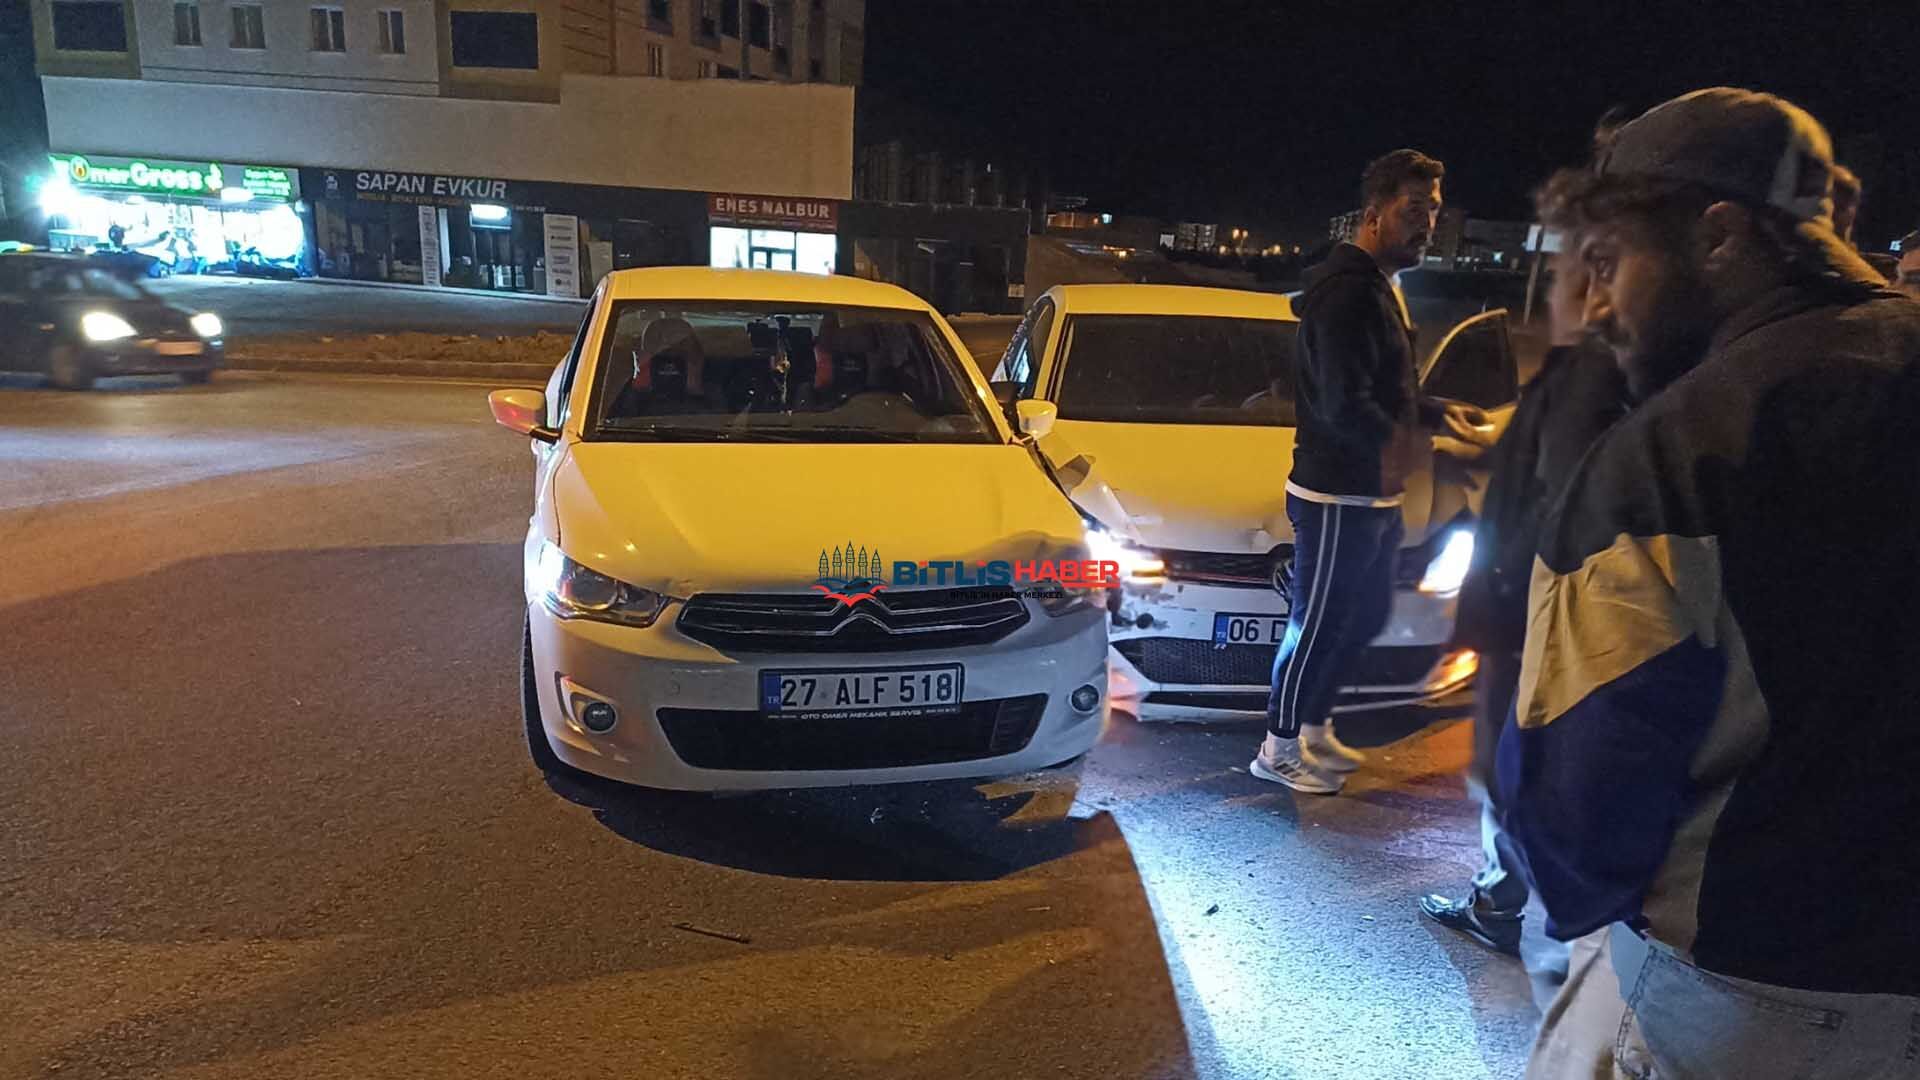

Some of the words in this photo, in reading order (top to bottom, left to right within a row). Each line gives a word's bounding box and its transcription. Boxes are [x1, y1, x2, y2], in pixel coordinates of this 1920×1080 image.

[356, 172, 426, 194] SAPAN
[433, 177, 507, 198] EVKUR
[716, 198, 757, 213] ENES
[762, 202, 830, 218] NALBUR
[1229, 619, 1259, 642] 06
[767, 696, 780, 704] TR
[781, 679, 816, 706] 27
[835, 677, 889, 705] ALF
[900, 673, 951, 702] 518
